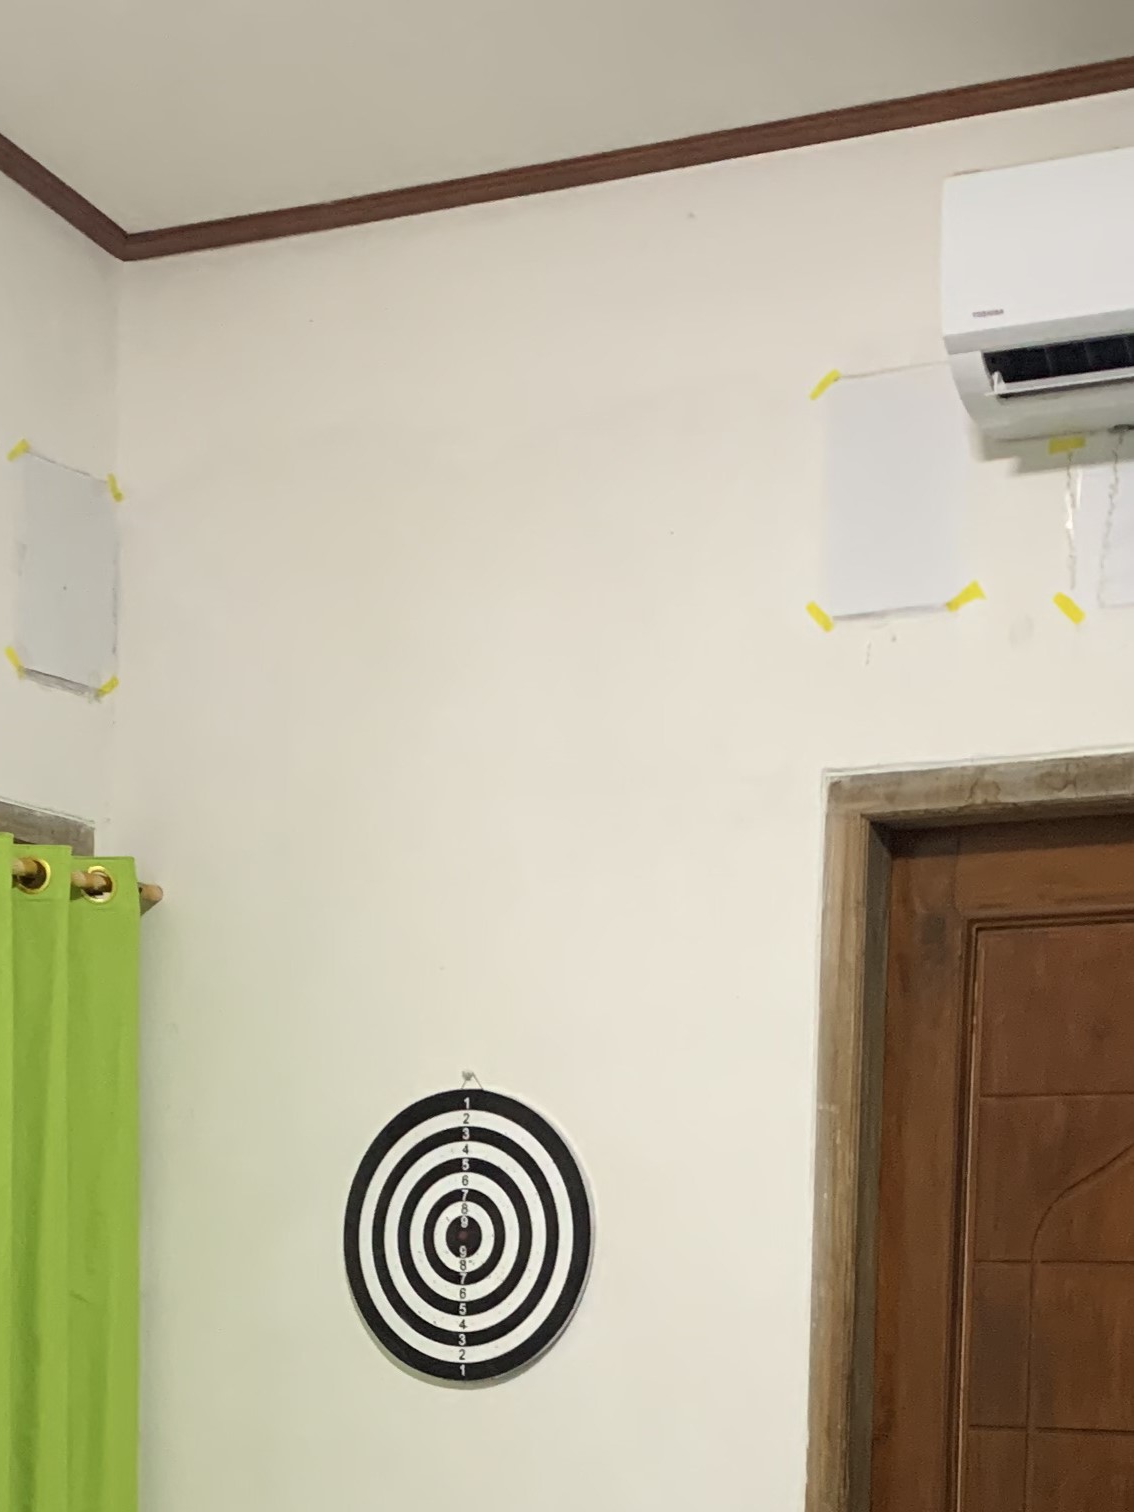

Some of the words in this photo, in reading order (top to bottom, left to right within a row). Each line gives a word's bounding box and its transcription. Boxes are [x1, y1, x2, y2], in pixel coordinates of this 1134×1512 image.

[463, 1096, 471, 1110] 1
[462, 1112, 470, 1125] 2
[462, 1127, 470, 1140] 3
[461, 1144, 469, 1154] 4
[461, 1158, 470, 1171] 5
[461, 1174, 469, 1187] 6
[461, 1189, 469, 1201] 7
[460, 1203, 468, 1215] 8
[459, 1245, 467, 1258] 9
[459, 1259, 467, 1271] 8
[458, 1272, 467, 1285] 7
[459, 1287, 466, 1300] 6
[458, 1302, 467, 1316] 5
[458, 1319, 467, 1330] 4
[458, 1333, 467, 1346] 3
[458, 1348, 466, 1361] 2
[459, 1363, 466, 1377] 1
